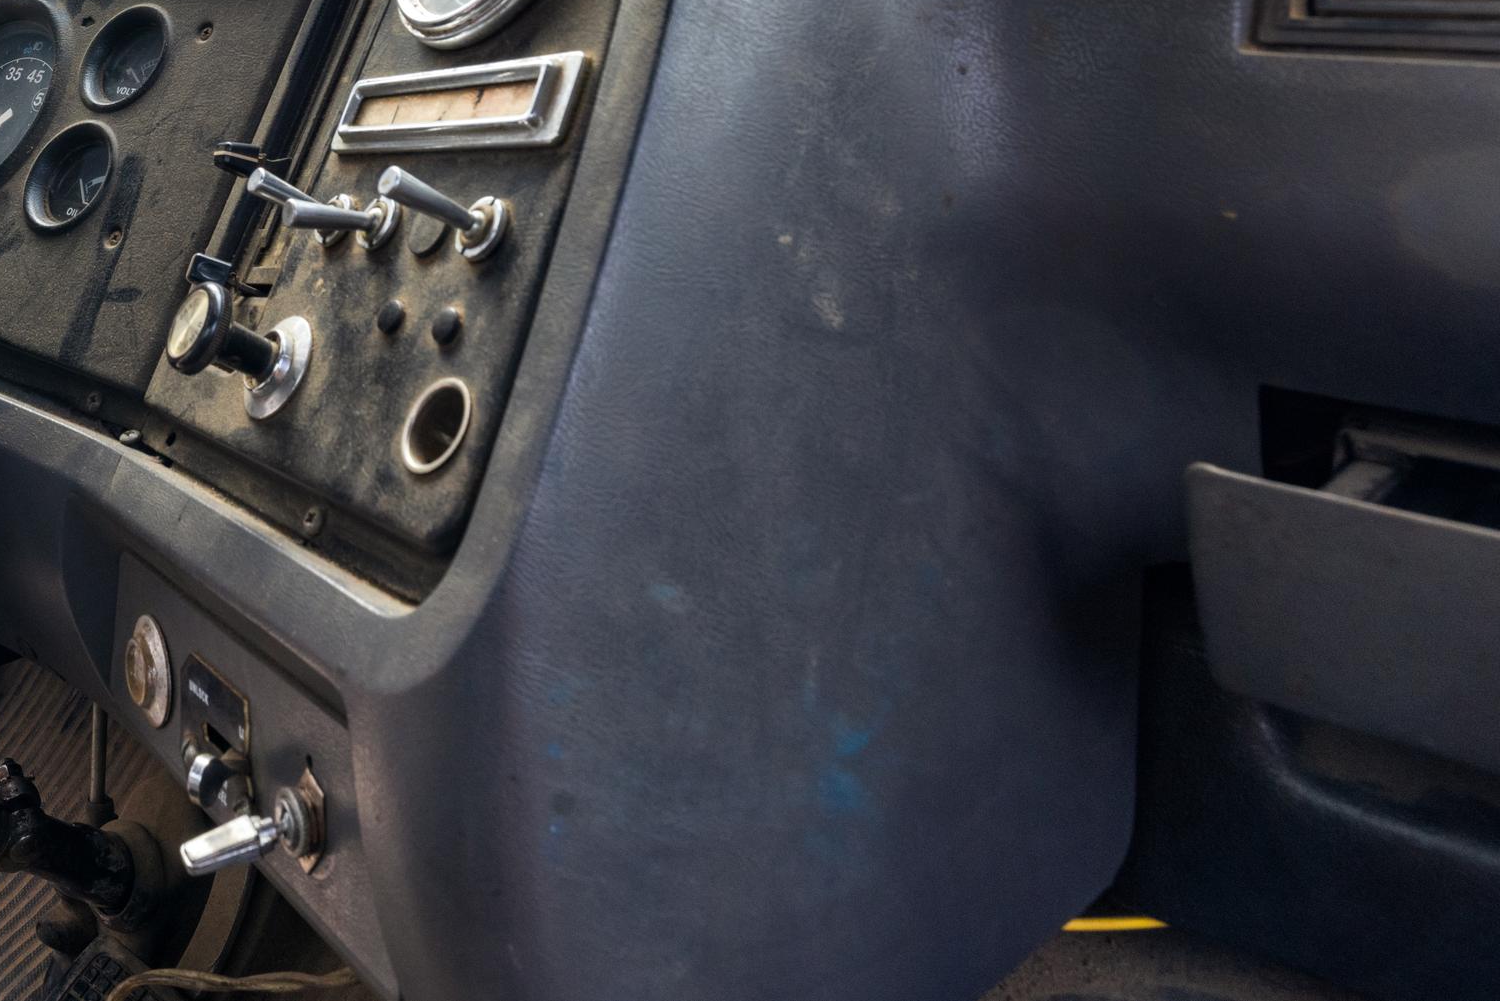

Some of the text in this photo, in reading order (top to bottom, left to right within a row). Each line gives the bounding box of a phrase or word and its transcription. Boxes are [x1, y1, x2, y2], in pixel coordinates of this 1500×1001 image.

[5, 66, 24, 81] 35
[26, 69, 45, 84] 45
[188, 679, 210, 707] UNLOCK
